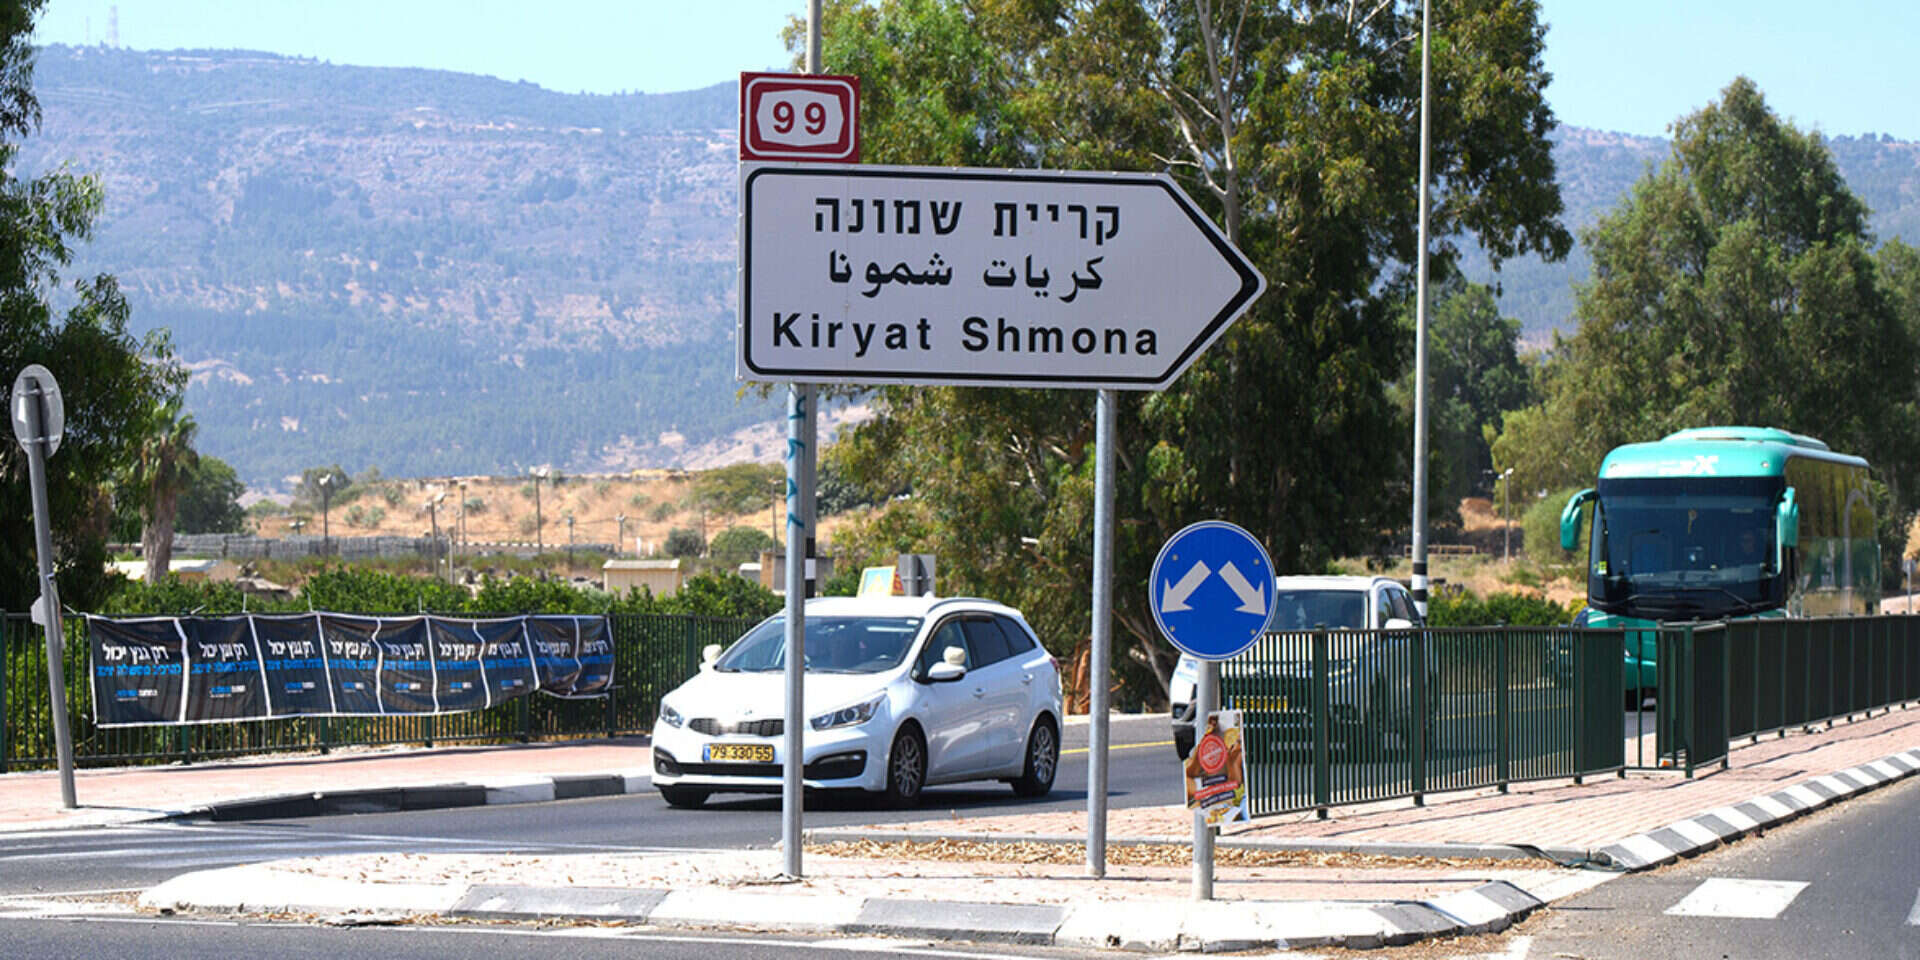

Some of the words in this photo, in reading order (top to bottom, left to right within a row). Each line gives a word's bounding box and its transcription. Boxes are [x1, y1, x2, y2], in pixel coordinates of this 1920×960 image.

[773, 101, 826, 135] 99
[816, 198, 962, 235] שמונה
[994, 203, 1119, 246] קריית
[830, 250, 952, 298] شمونا
[984, 255, 1104, 303] كريات
[774, 313, 931, 358] Kiryat
[962, 317, 1157, 355] Shmona
[129, 646, 152, 664] גנץ
[151, 646, 169, 664] רק
